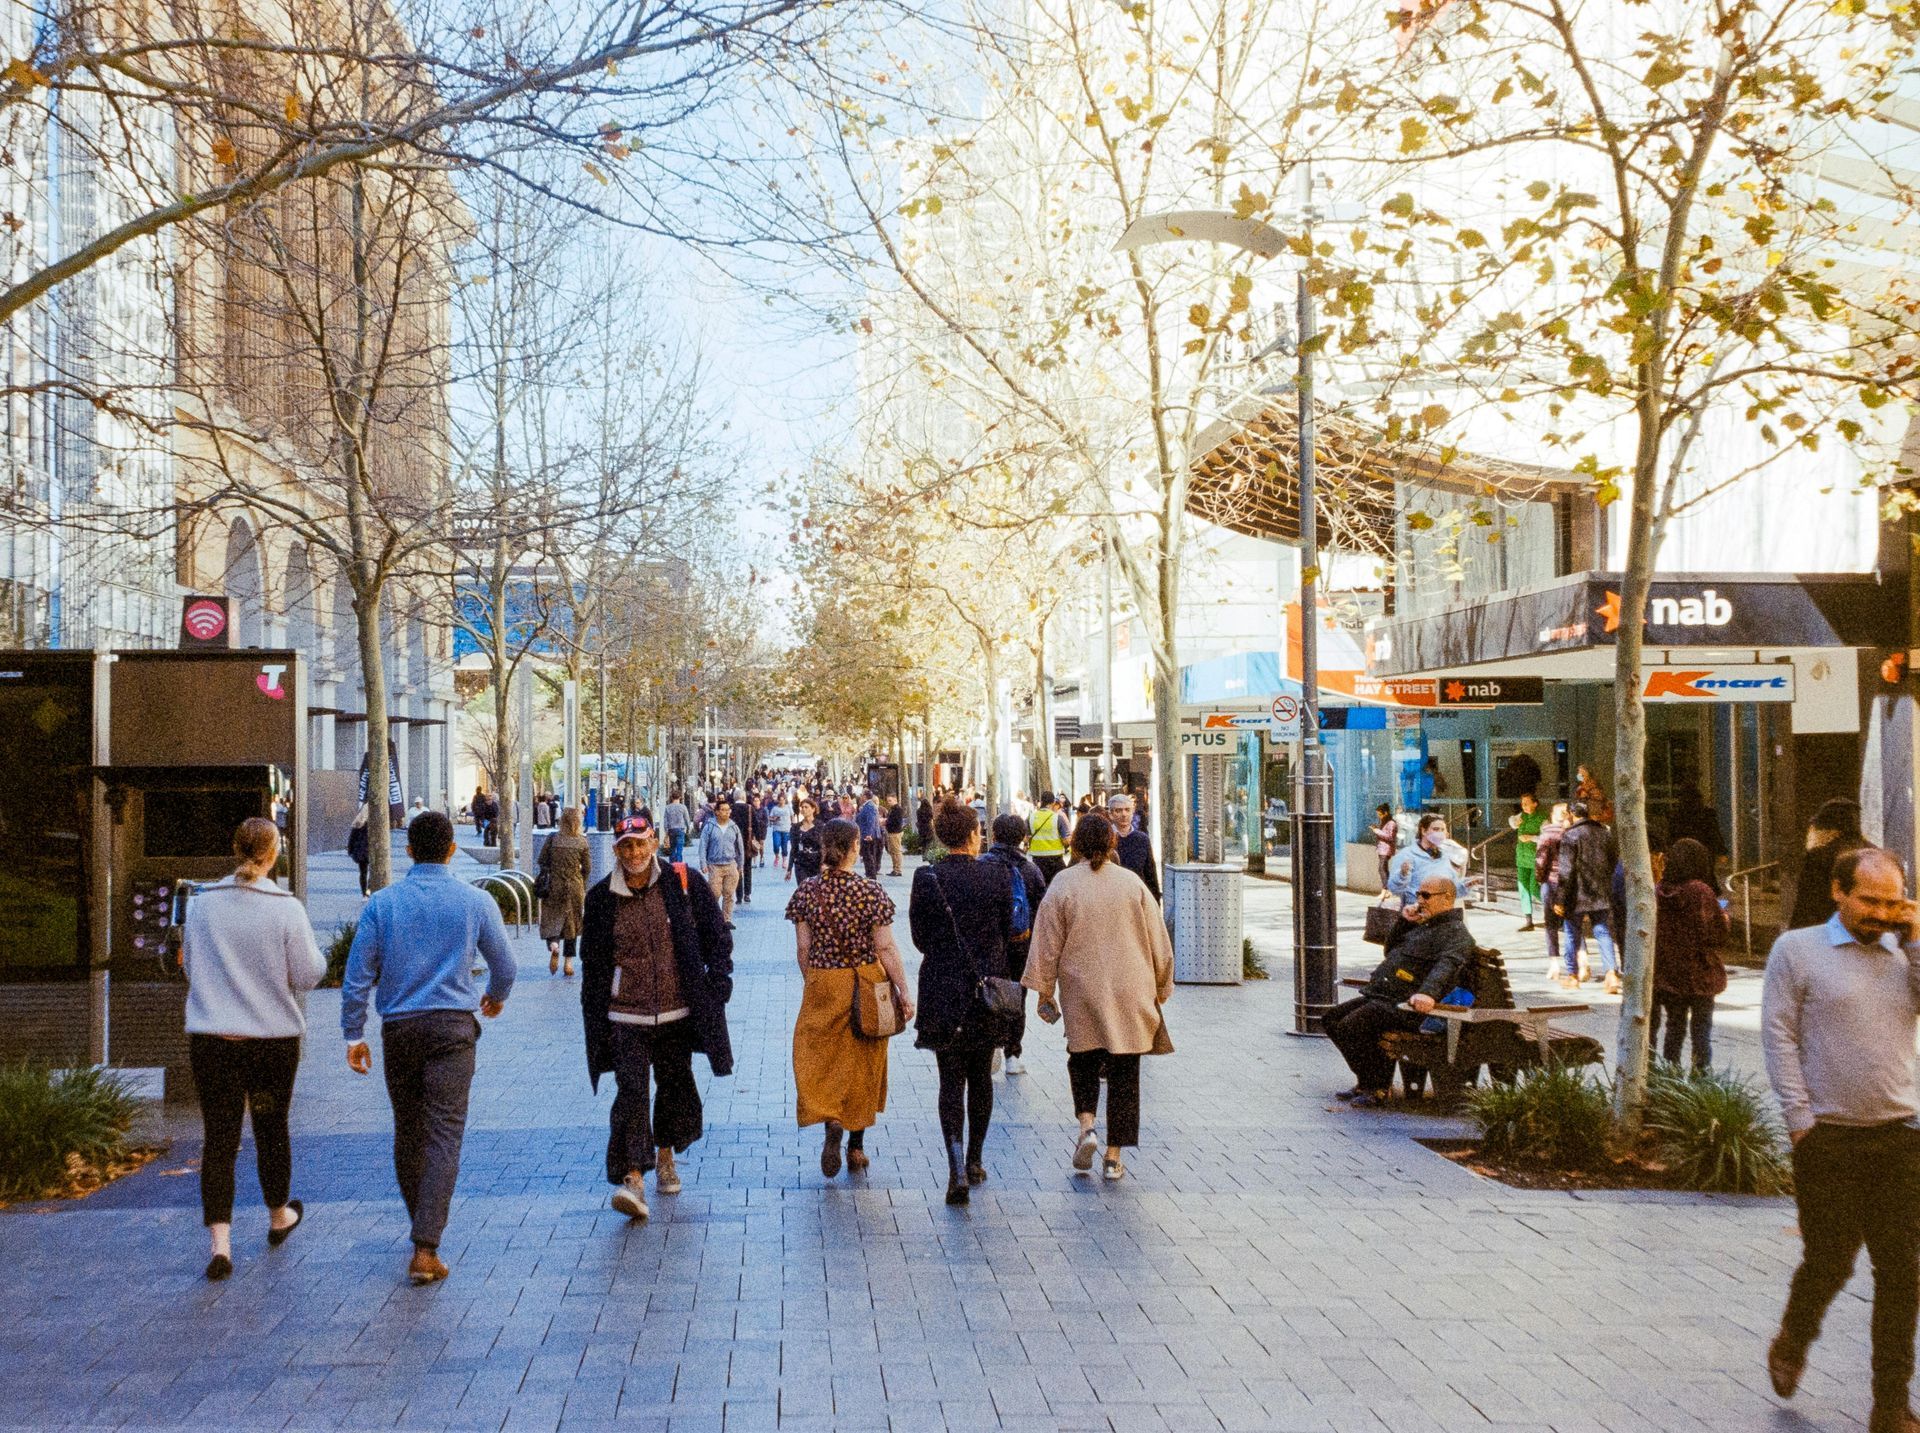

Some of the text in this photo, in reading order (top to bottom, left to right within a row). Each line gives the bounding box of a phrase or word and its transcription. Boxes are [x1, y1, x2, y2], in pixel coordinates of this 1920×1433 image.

[1651, 590, 1732, 626] nab
[1354, 683, 1436, 695] HAY STREET
[1468, 682, 1501, 697] nab
[1642, 671, 1787, 697] Kmart
[1181, 733, 1226, 746] PTUS
